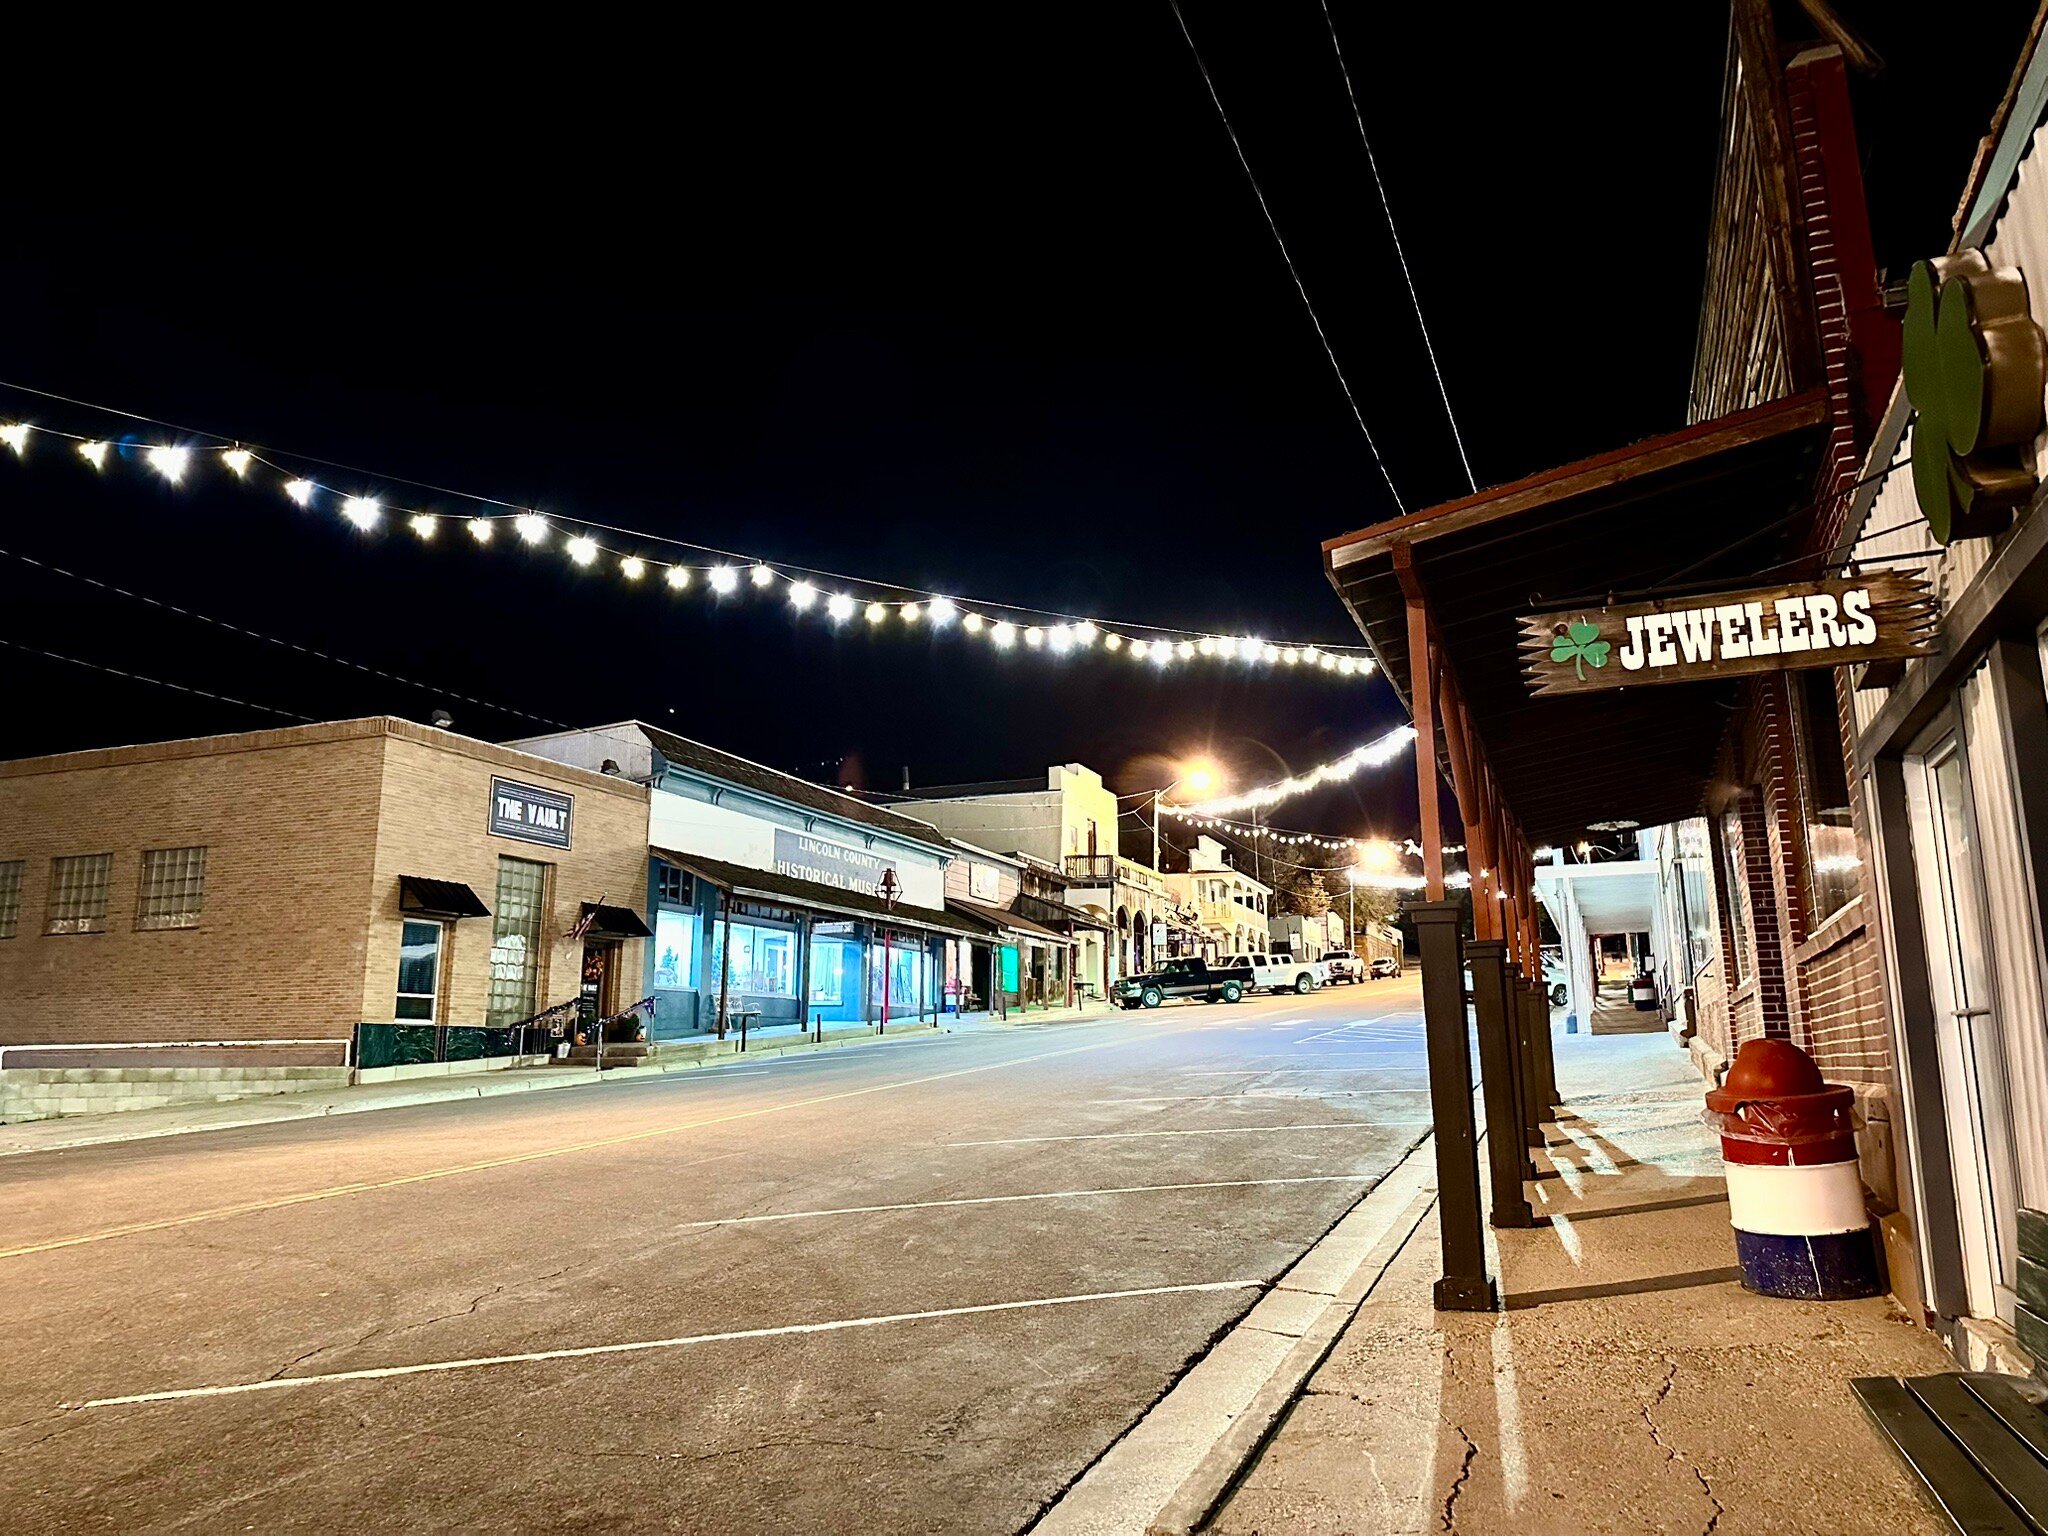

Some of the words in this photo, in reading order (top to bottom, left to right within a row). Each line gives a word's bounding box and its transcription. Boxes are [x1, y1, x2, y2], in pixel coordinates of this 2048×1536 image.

[1620, 589, 1877, 670] JEWELERS
[497, 796, 523, 821] THE
[527, 803, 568, 831] VAULT
[799, 837, 841, 860] LINCOLN
[843, 849, 881, 869] COUNTY
[777, 860, 846, 889] HISTORICAL
